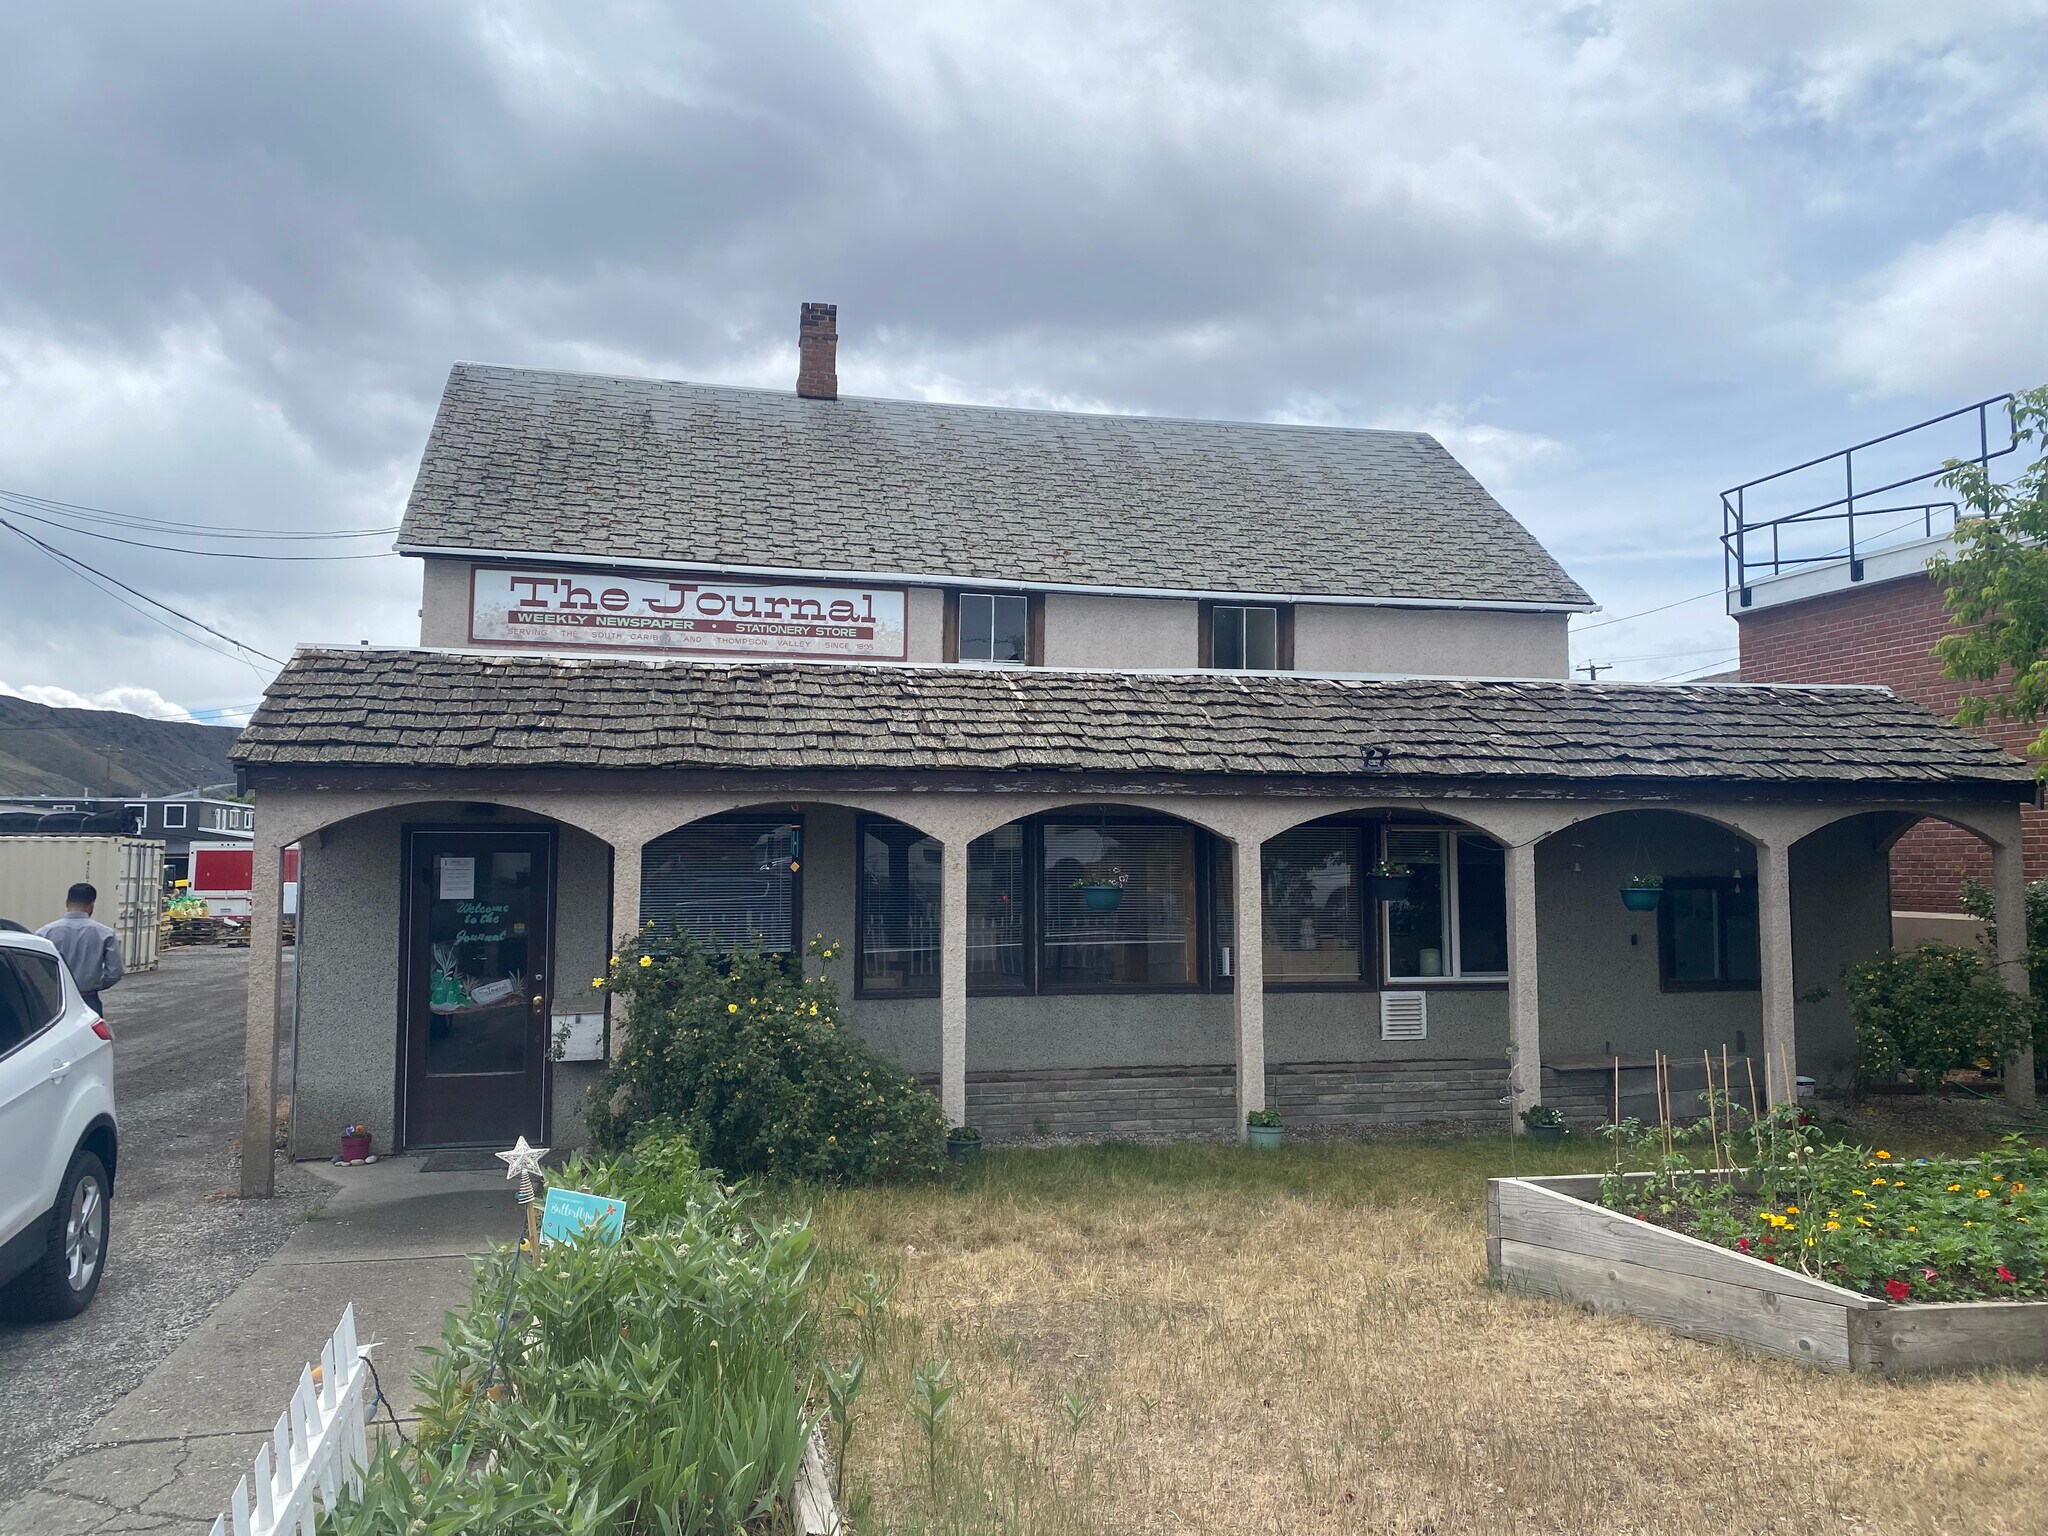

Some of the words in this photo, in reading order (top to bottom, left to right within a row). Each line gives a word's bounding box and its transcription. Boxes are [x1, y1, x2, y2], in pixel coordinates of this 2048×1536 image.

[510, 576, 629, 611] The
[642, 584, 876, 623] Journal
[518, 613, 588, 625] WEEKLY
[596, 617, 694, 630] NEWSPAPER
[507, 628, 548, 636] SERVING
[716, 638, 768, 646] THOMPSON
[735, 623, 810, 636] STATIONERY
[816, 628, 857, 637] STORE
[456, 902, 509, 914] Welcome
[480, 912, 499, 924] the
[454, 929, 507, 945] Journal
